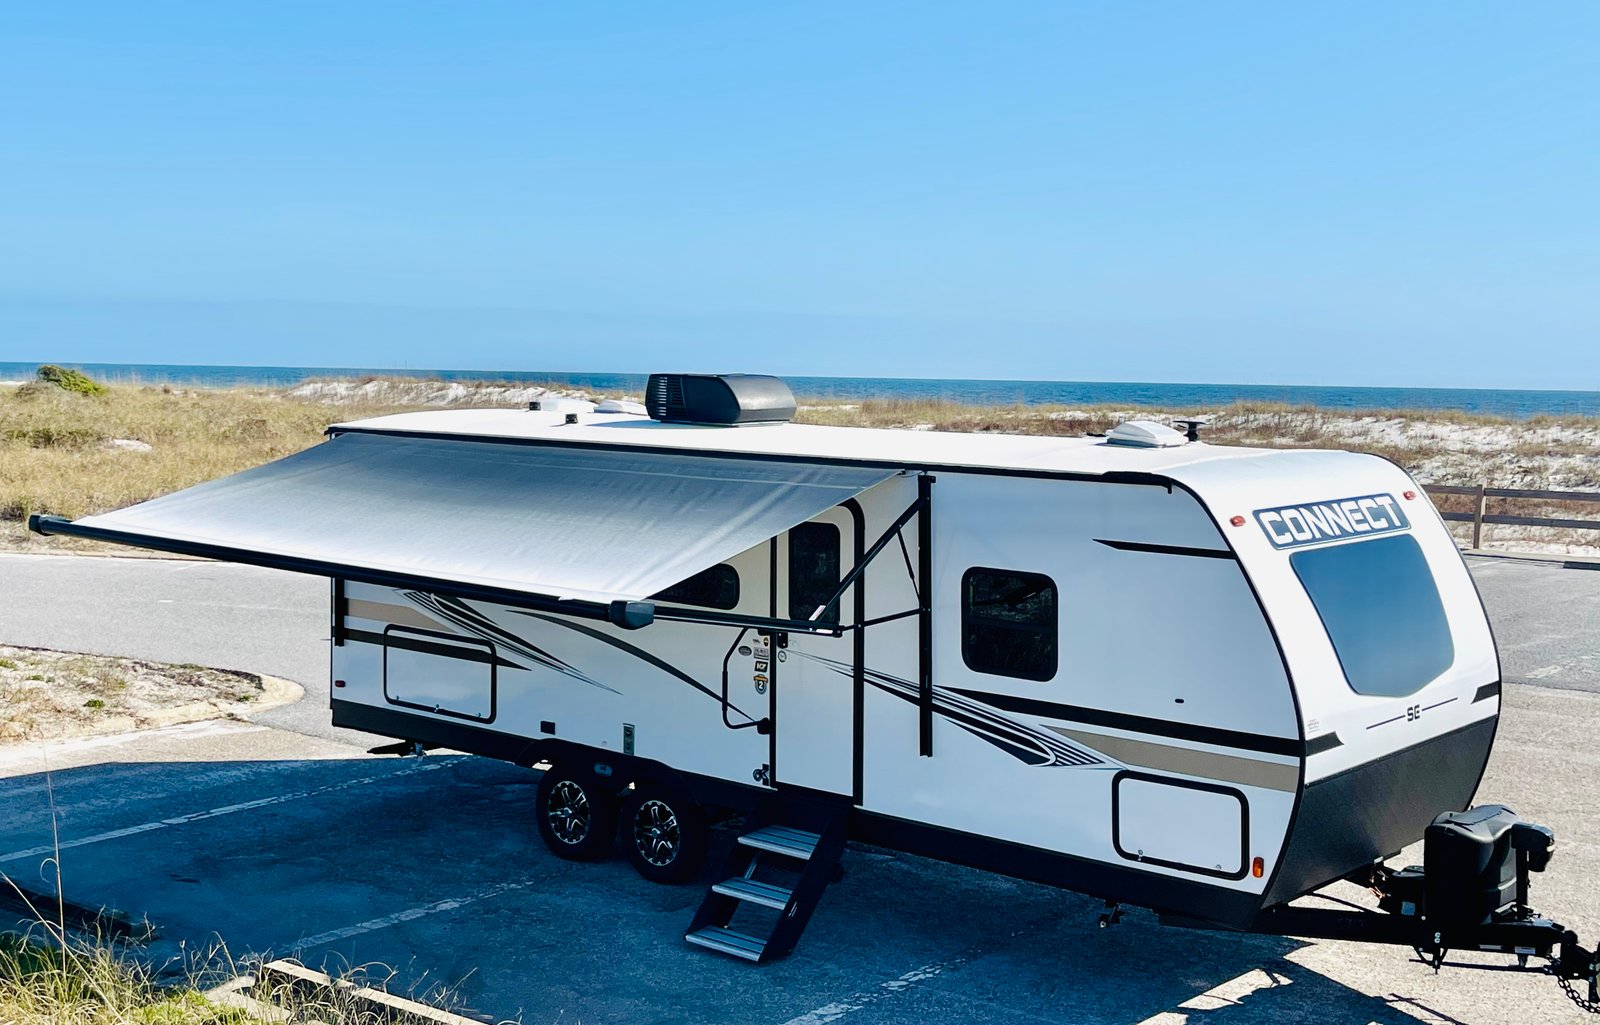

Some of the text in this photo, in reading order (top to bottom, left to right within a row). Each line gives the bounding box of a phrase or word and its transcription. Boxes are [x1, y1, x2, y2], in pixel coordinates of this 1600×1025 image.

[1259, 496, 1401, 545] CONNECT
[758, 681, 764, 689] 2
[1406, 704, 1421, 722] SE
